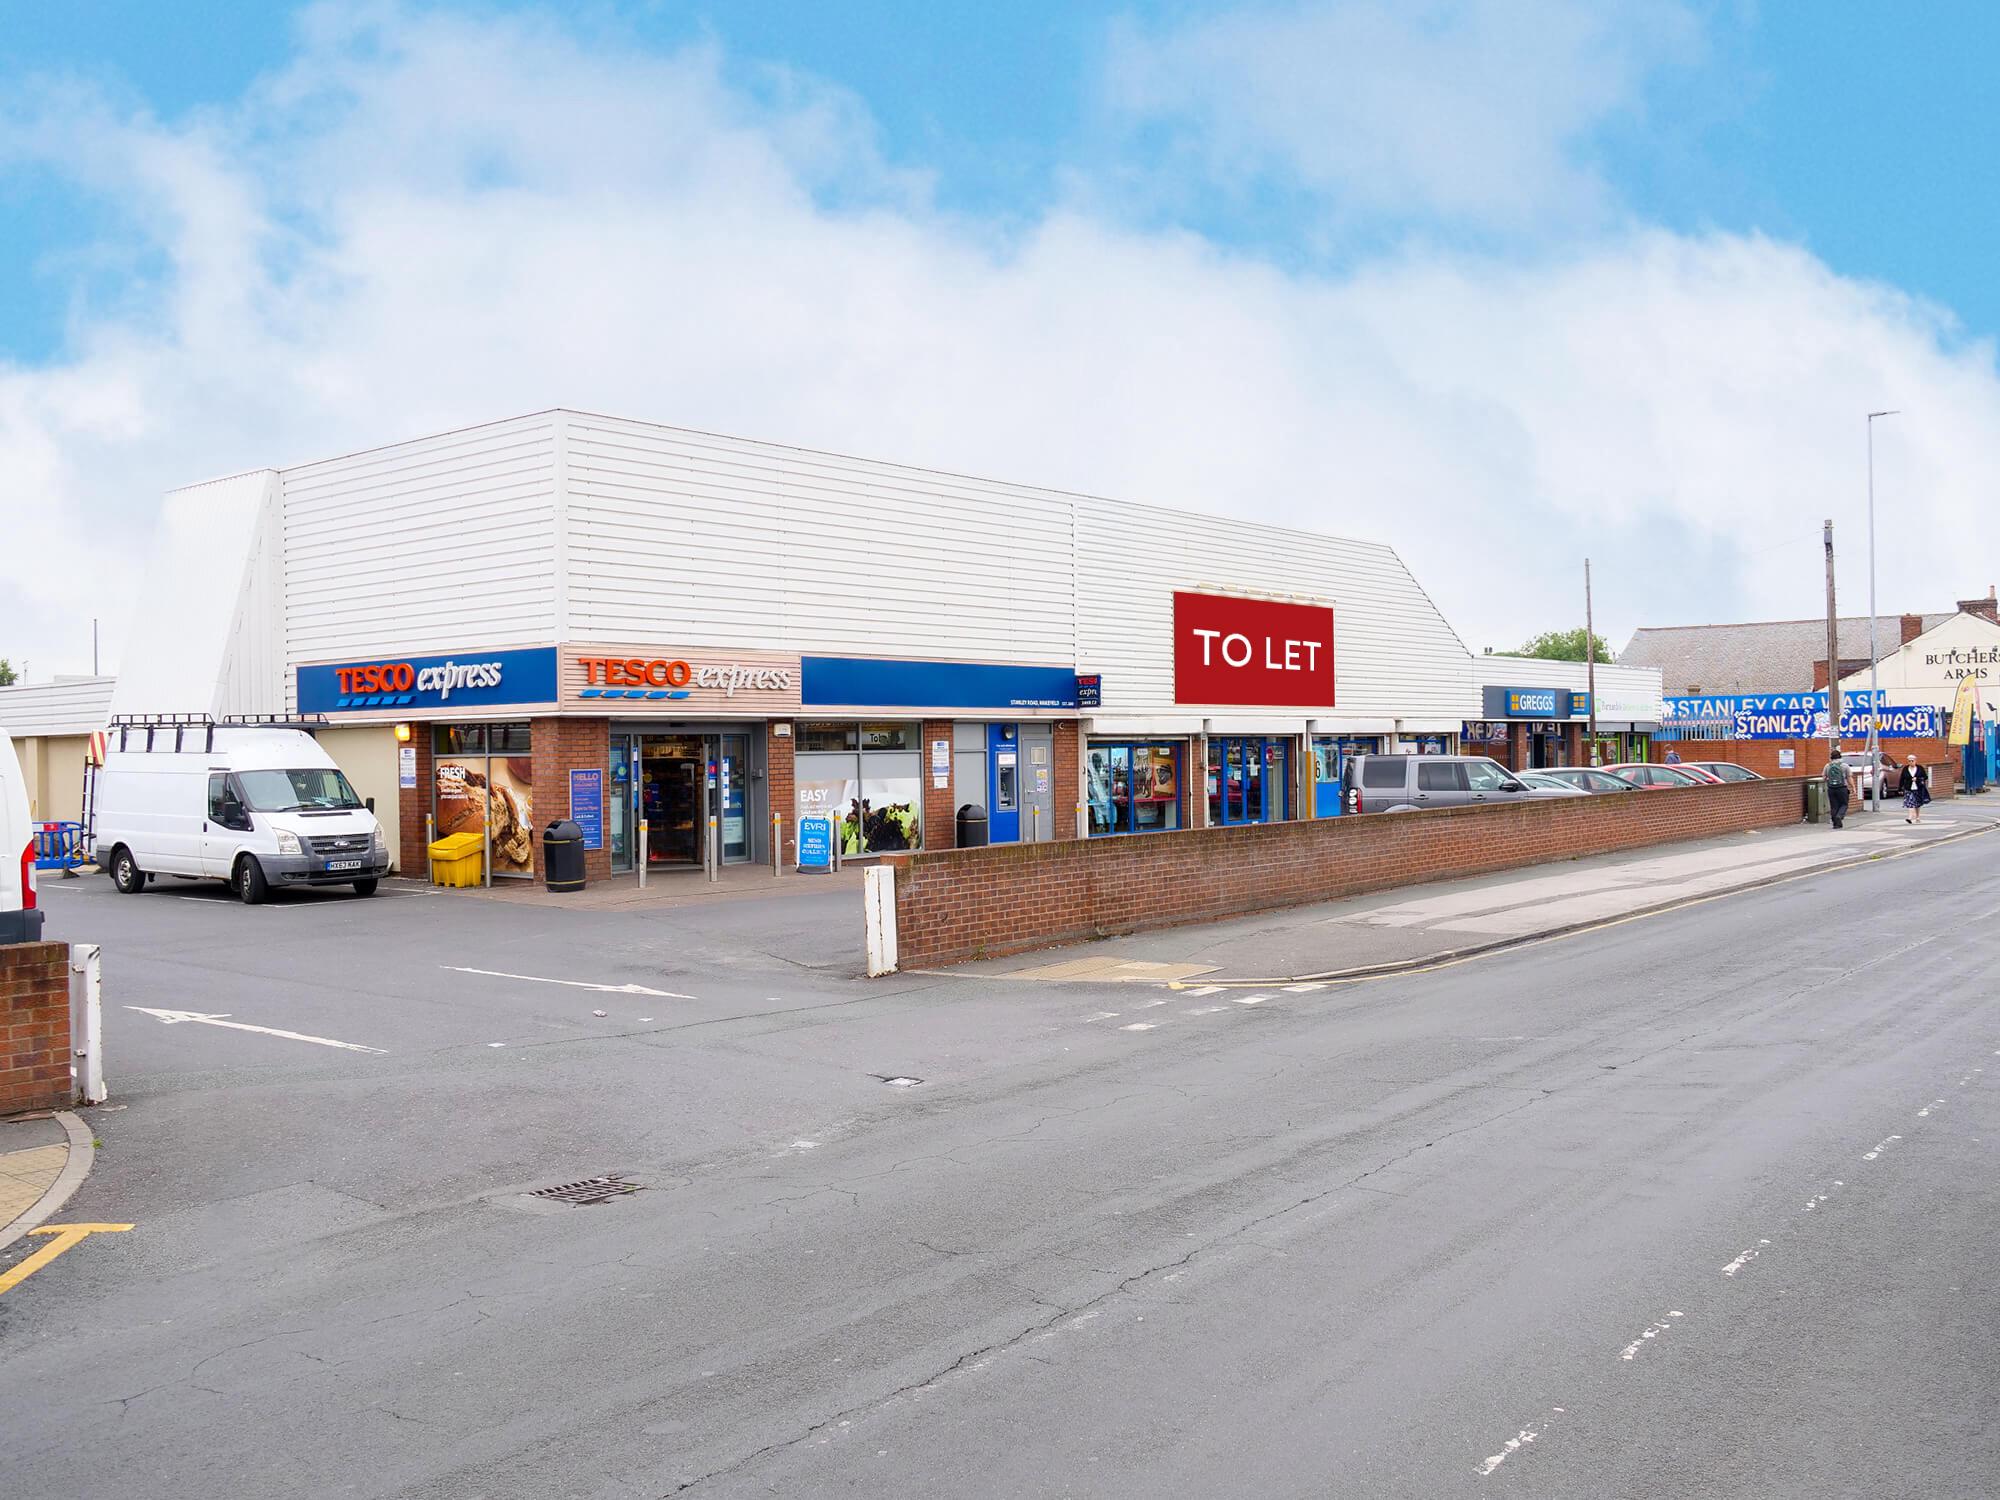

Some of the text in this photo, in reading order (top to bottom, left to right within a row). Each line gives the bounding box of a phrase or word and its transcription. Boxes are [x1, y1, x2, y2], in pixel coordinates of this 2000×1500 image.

[1193, 628, 1322, 672] TO LET
[1925, 652, 2000, 665] BUTCHER
[335, 661, 502, 700] TESCO express
[578, 657, 793, 698] TESCO express
[1520, 694, 1554, 711] GREGGS
[1736, 712, 1929, 734] STANLEY CAR WASH
[440, 767, 465, 779] FRESH
[575, 773, 598, 781] HELLO
[800, 789, 828, 802] EASY
[804, 822, 826, 831] EVRI
